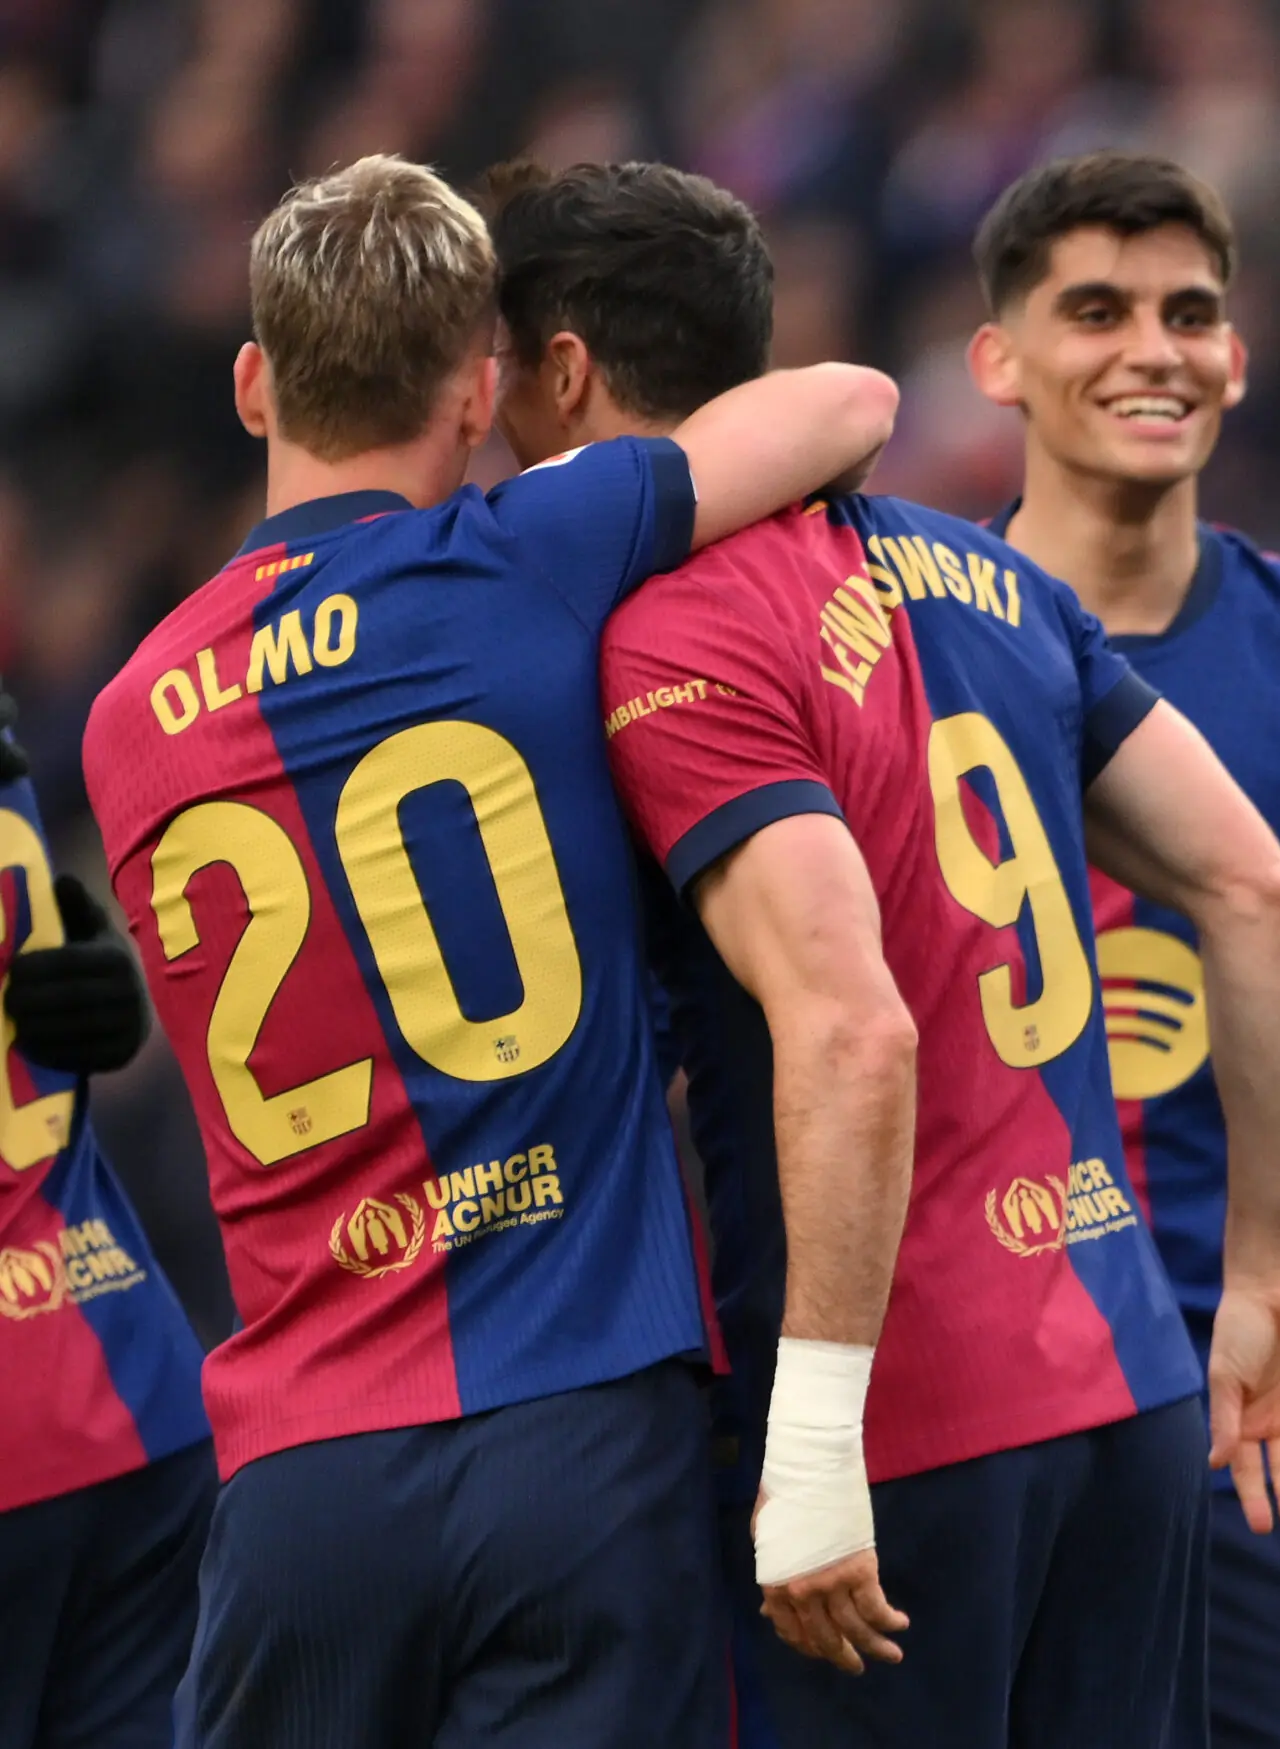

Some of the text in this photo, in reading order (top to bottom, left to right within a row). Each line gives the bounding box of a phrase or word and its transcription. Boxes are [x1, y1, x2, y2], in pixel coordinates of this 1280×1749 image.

[150, 593, 358, 735] OLMO
[604, 679, 707, 739] MBILIGHT
[927, 712, 1092, 1068] 9
[150, 720, 583, 1167] 20
[423, 1144, 557, 1210] UNHCR
[431, 1175, 563, 1241] ACNUR
[1065, 1186, 1132, 1230] CNUR
[1066, 1156, 1114, 1196] HCR
[432, 1240, 452, 1253] The
[454, 1231, 472, 1247] UN
[520, 1208, 564, 1225] Agency
